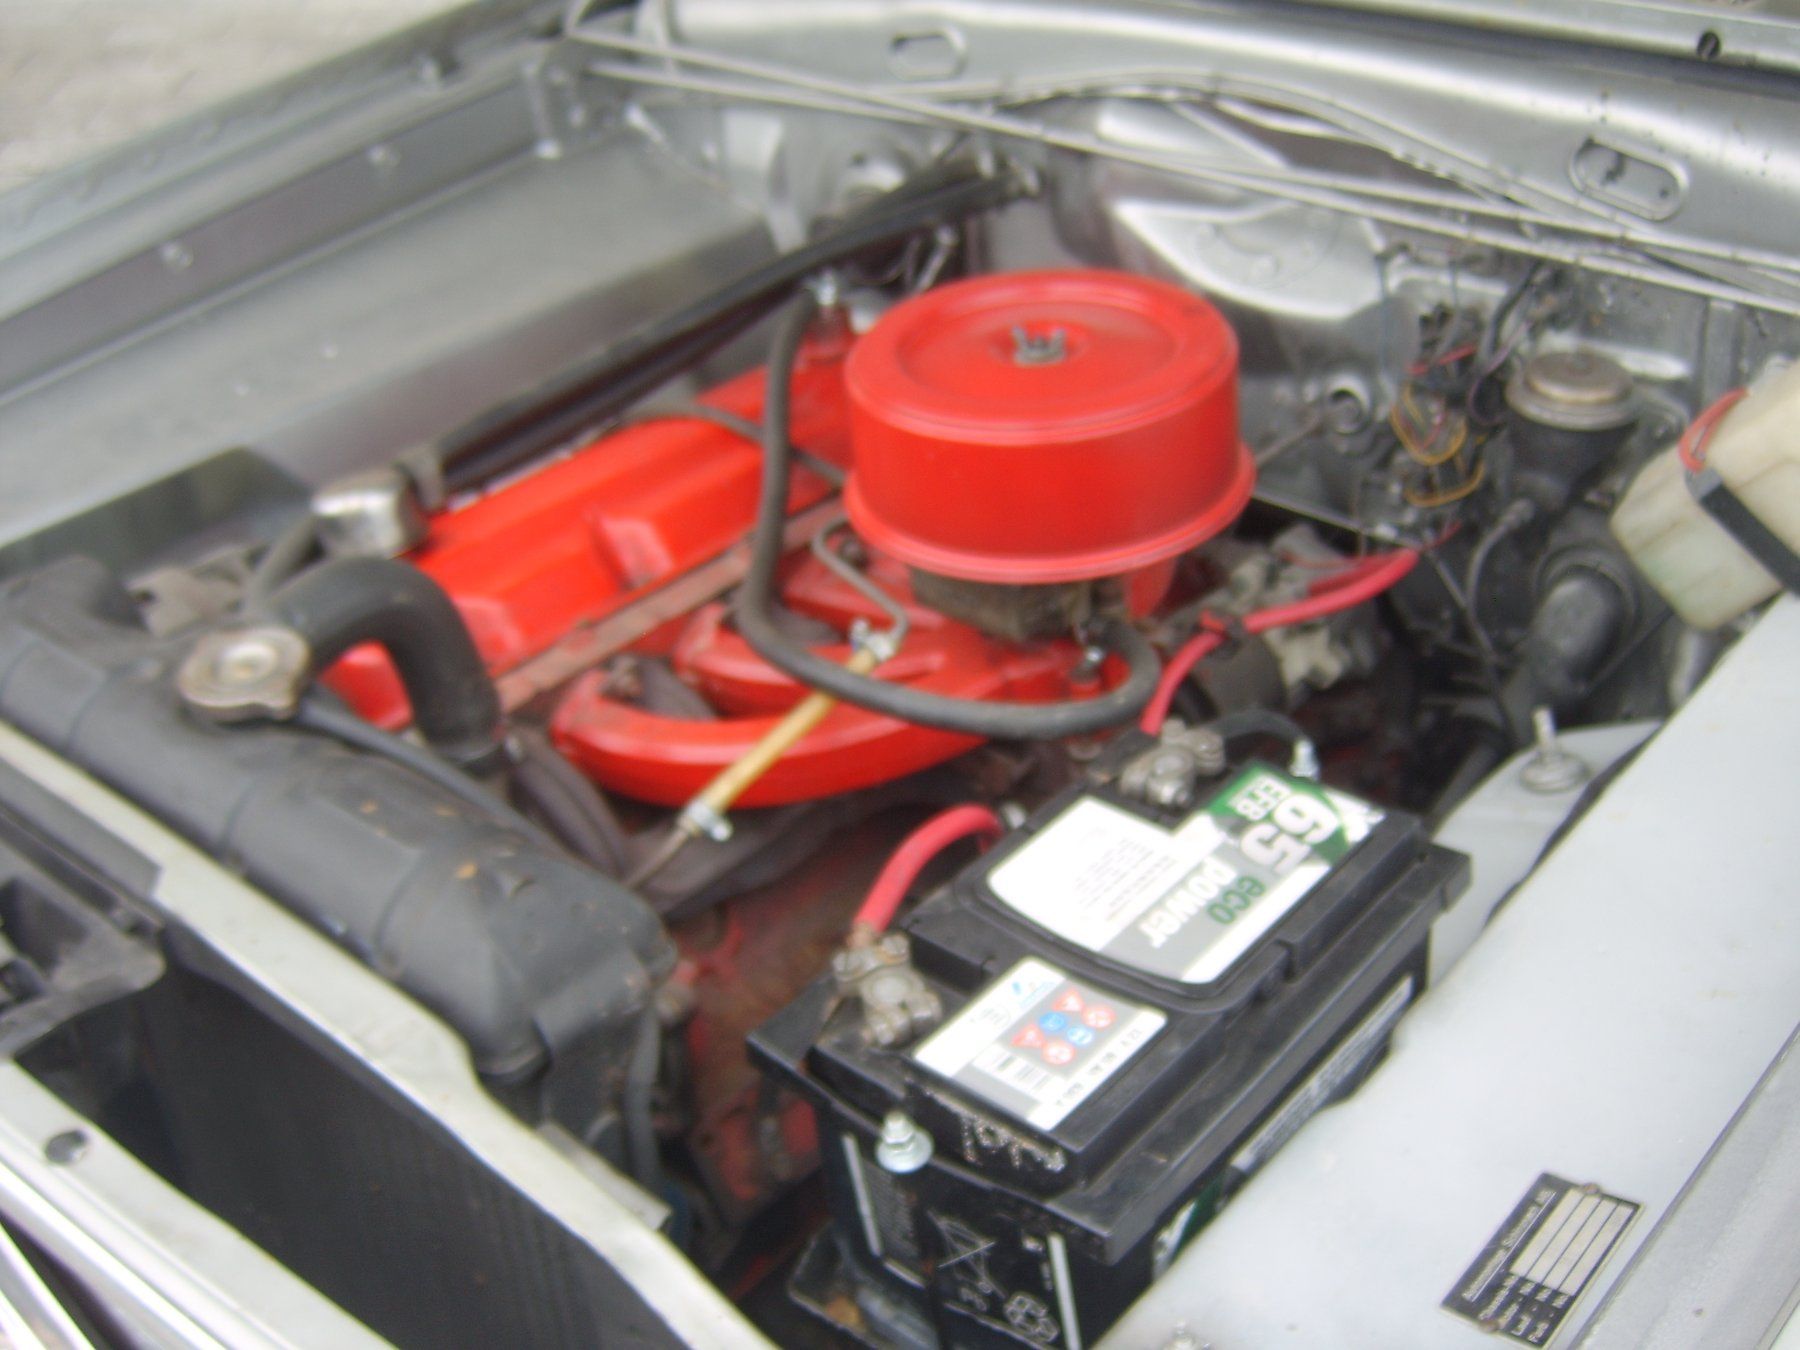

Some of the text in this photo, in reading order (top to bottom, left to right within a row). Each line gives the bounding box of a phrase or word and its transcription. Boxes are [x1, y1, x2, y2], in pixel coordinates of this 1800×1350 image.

[1228, 772, 1291, 820] EFB
[1241, 793, 1339, 876] 65
[1139, 856, 1238, 949] power
[1206, 875, 1267, 925] eco
